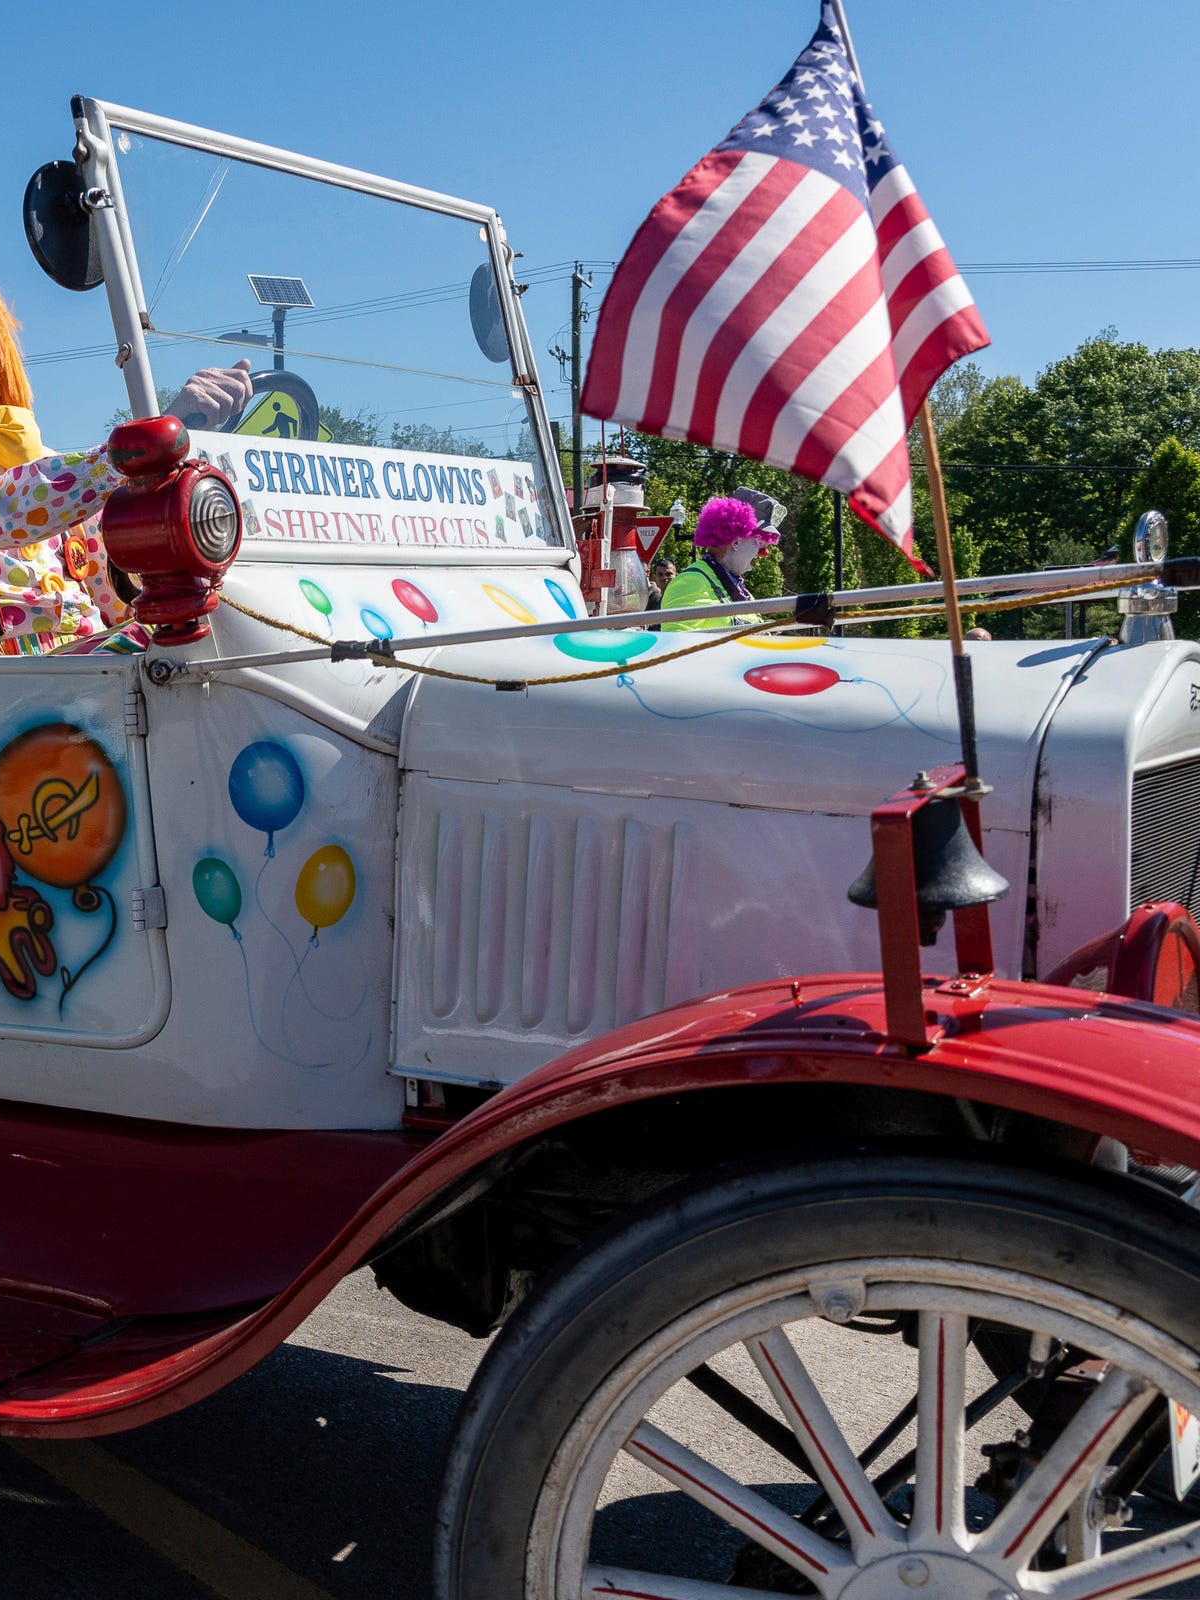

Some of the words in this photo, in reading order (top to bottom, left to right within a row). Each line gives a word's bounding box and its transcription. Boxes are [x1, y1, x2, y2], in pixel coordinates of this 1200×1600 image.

[244, 449, 381, 499] SHRINER
[383, 461, 487, 506] CLOWNS
[263, 508, 387, 543] SHRINE
[391, 514, 490, 546] CIRCUS
[640, 529, 656, 537] YIELD
